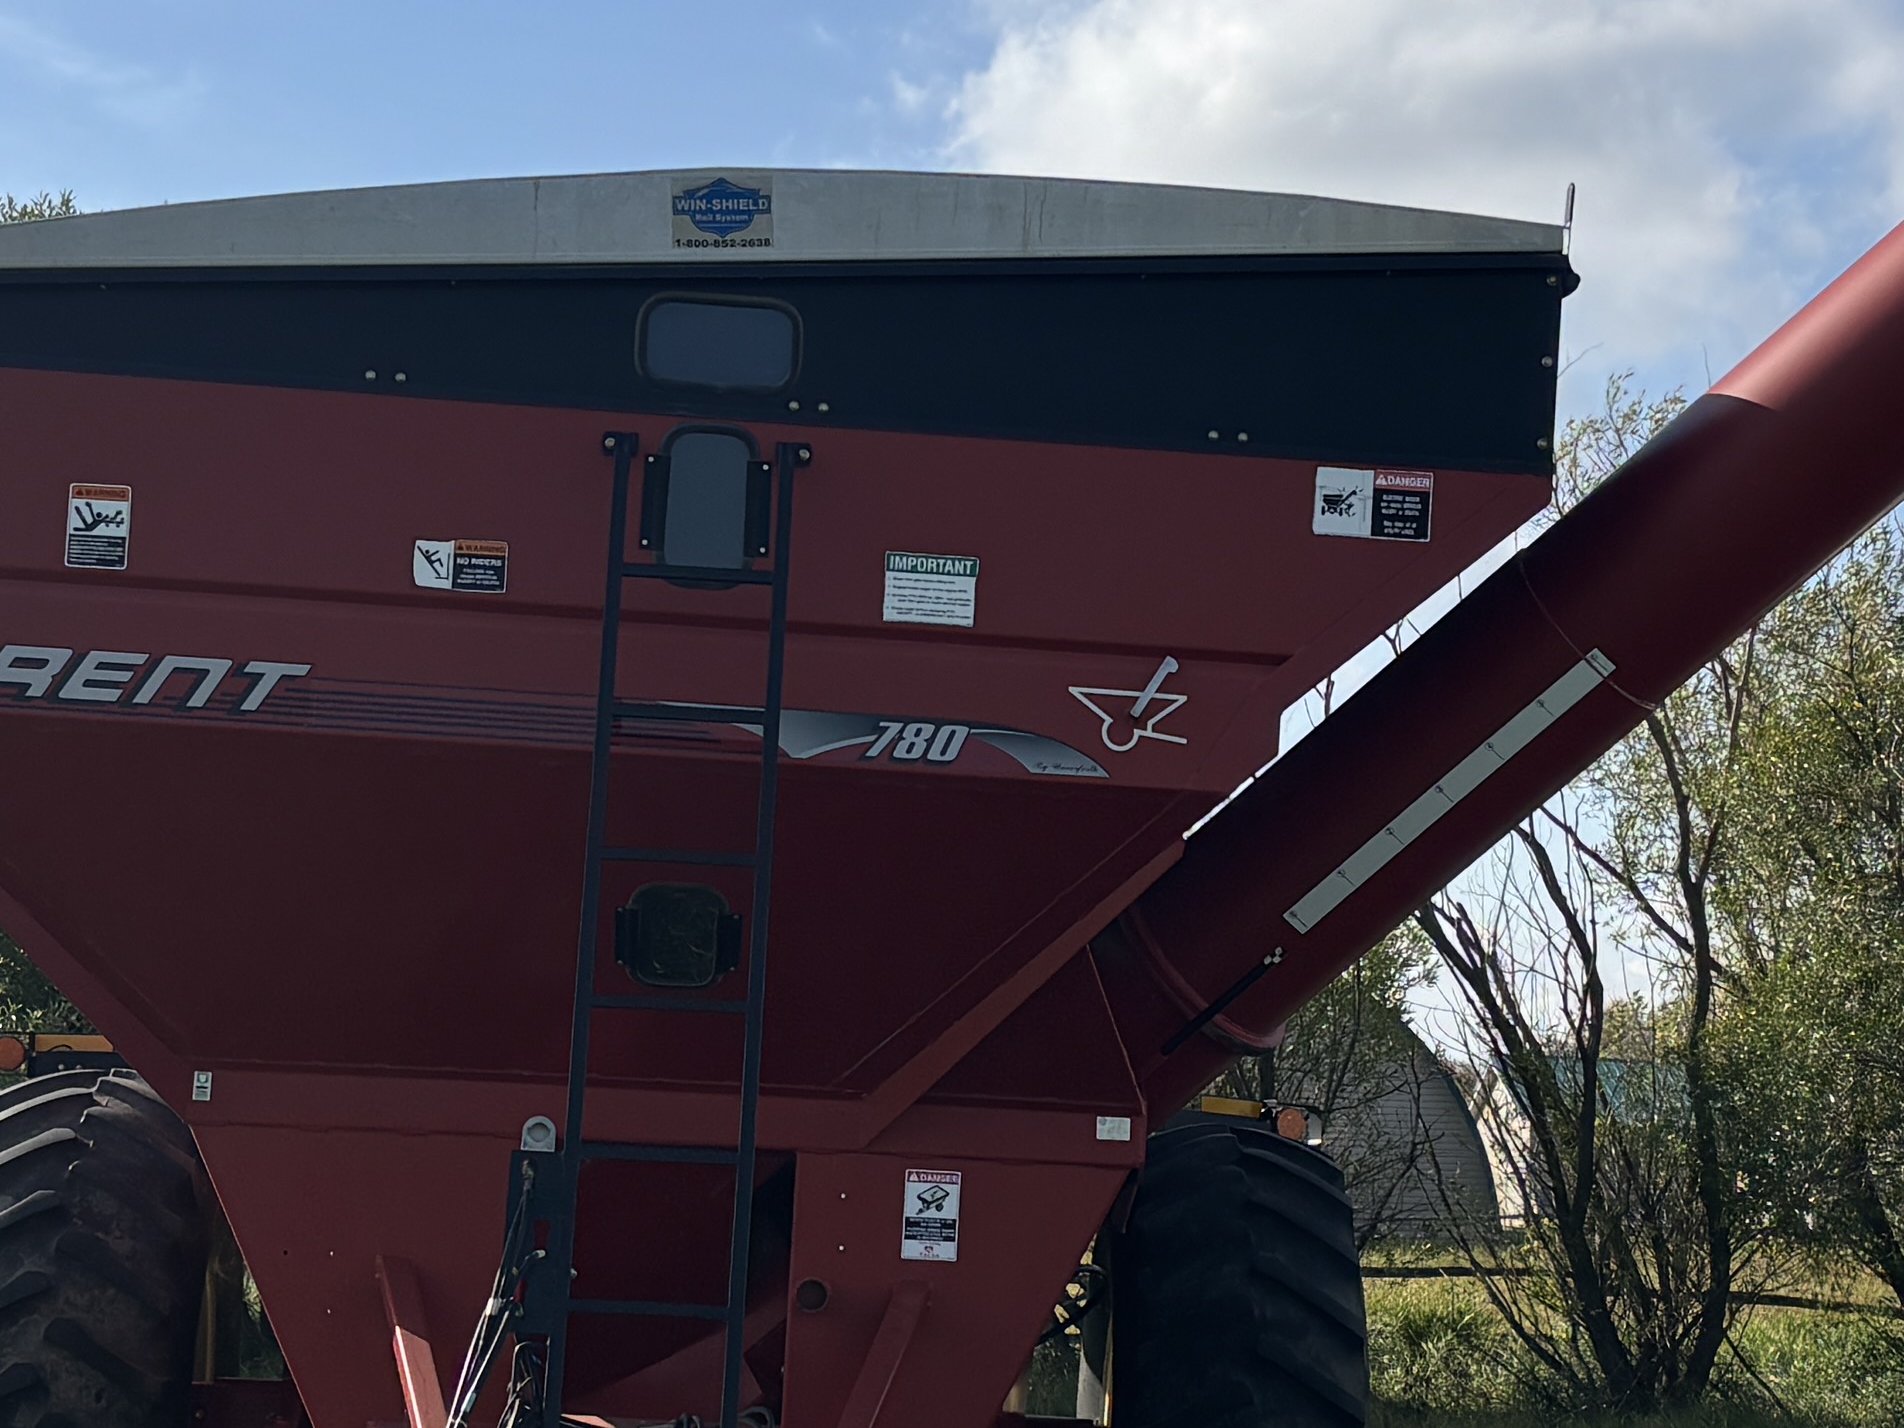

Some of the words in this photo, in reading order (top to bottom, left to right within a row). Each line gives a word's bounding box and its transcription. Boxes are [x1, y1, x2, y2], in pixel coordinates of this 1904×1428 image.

[675, 198, 769, 211] WIN-SHIELD
[1387, 475, 1430, 488] DANGER
[889, 555, 974, 575] IMPORTANT
[864, 721, 971, 762] 780
